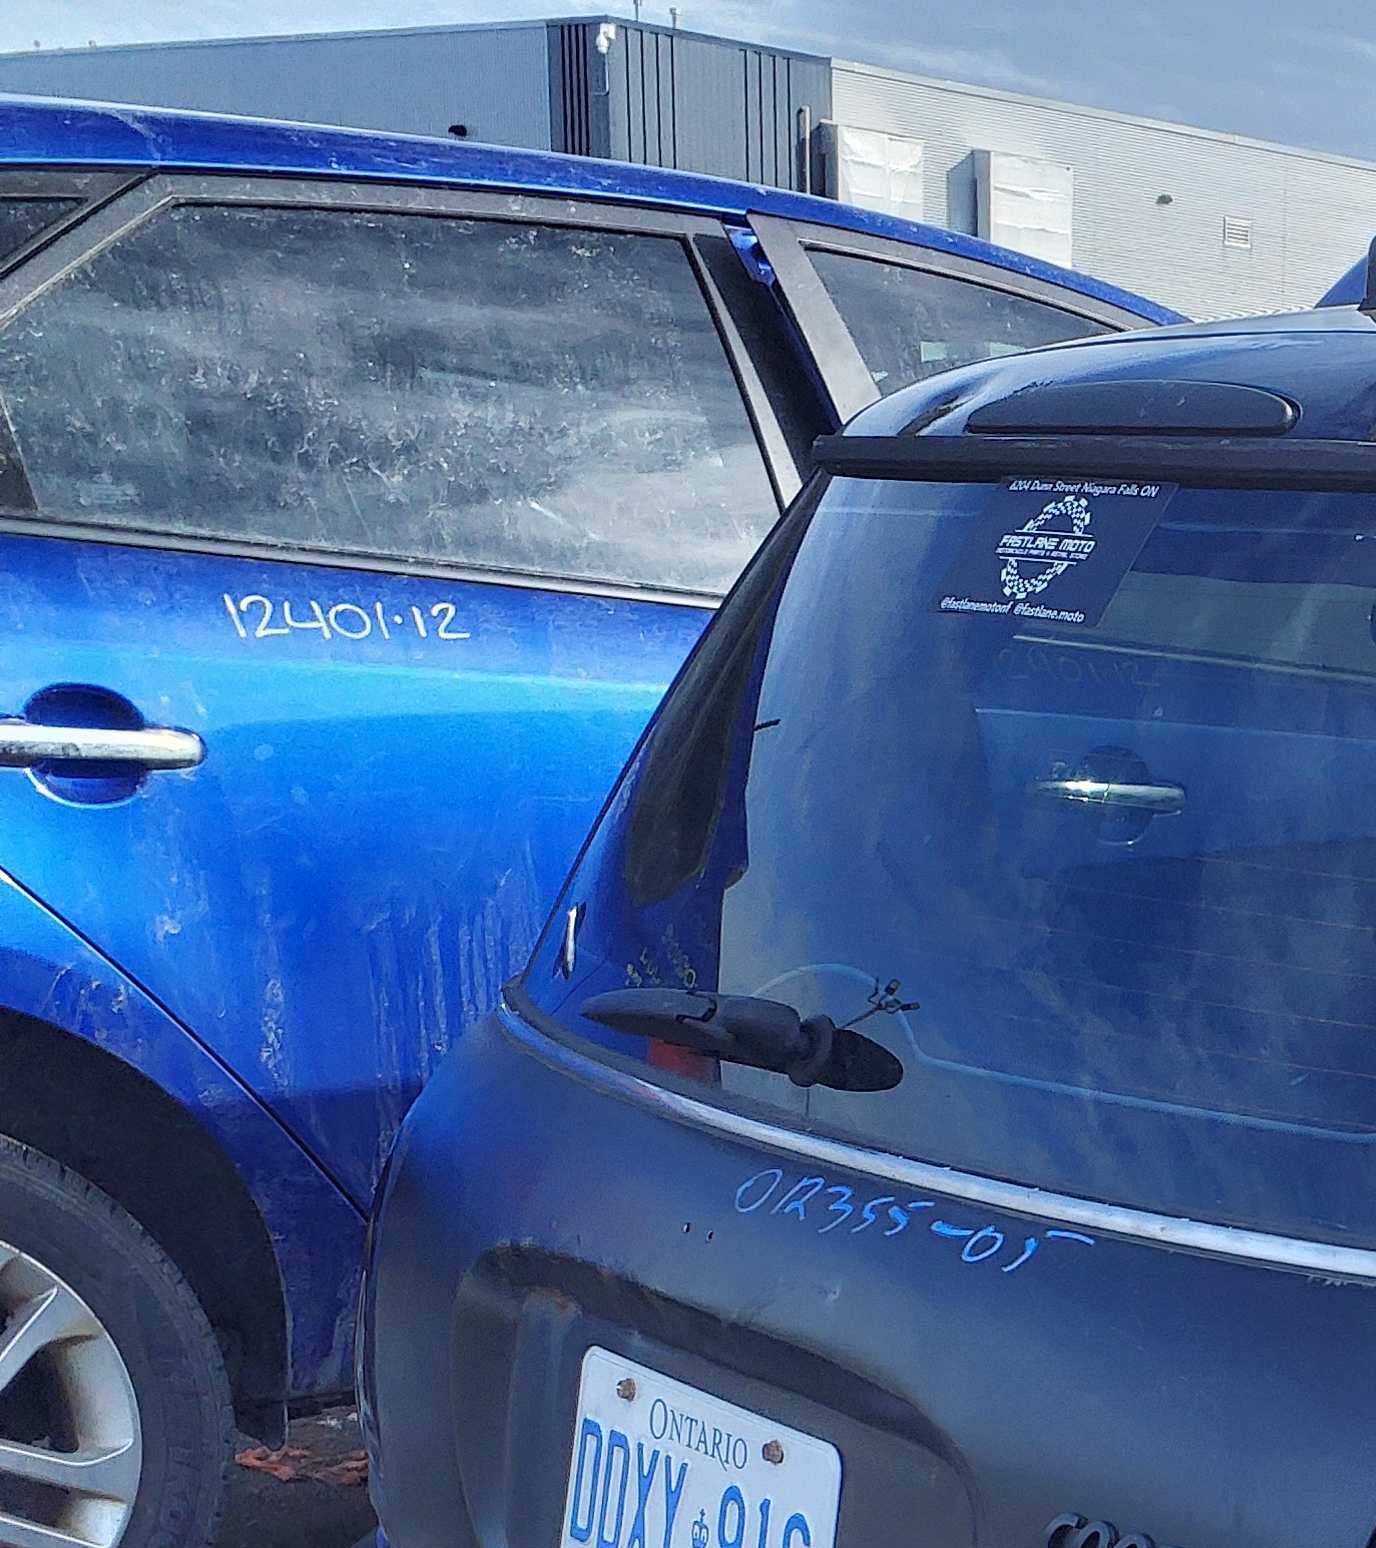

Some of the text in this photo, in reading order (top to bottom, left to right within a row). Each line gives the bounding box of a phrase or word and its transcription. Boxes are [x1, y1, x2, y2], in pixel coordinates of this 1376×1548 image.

[1053, 481, 1081, 492] Street
[1081, 483, 1116, 496] Niagara
[1117, 485, 1139, 496] Falls
[1140, 486, 1160, 498] ON
[999, 535, 1096, 553] FASTLANE MOTO
